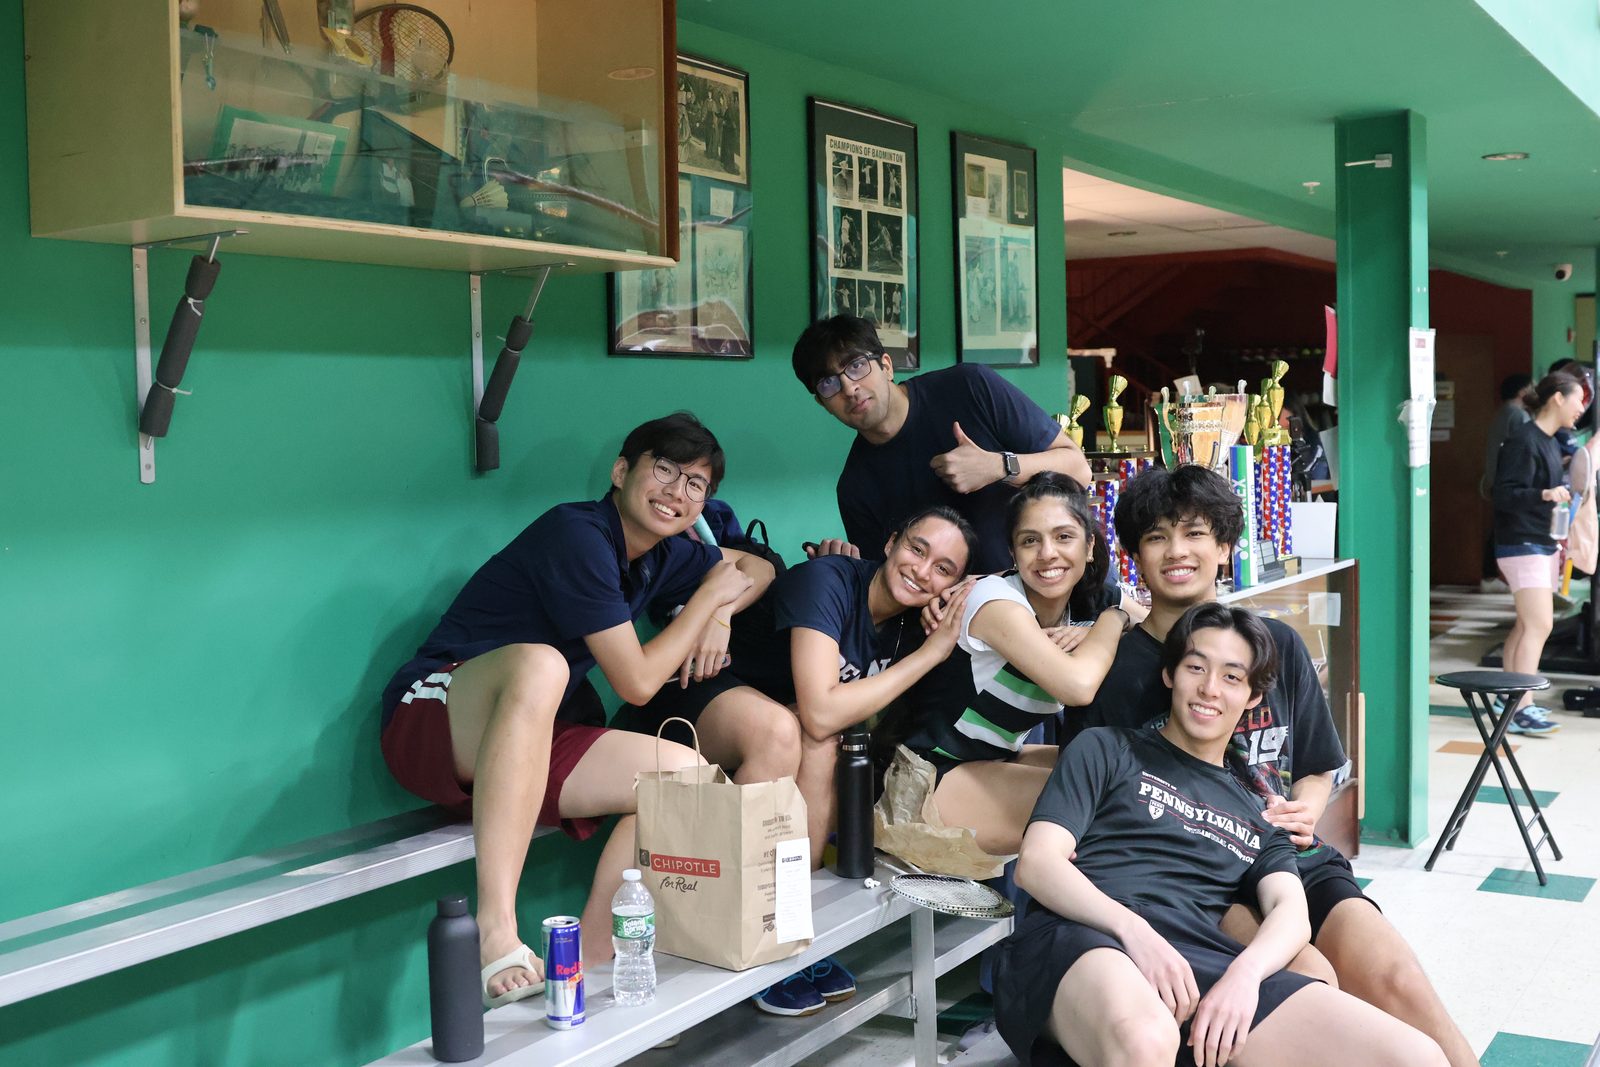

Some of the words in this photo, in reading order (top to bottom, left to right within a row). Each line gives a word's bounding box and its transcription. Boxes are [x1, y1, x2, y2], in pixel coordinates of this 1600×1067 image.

[829, 139, 862, 155] CHAMPIONS
[864, 147, 871, 156] OF
[872, 149, 903, 163] BADMINTON
[1139, 781, 1261, 849] PENNSYLVANIA
[653, 858, 717, 874] CHIPOTLE
[660, 876, 674, 890] for
[675, 876, 698, 893] Real
[555, 962, 579, 976] Red
